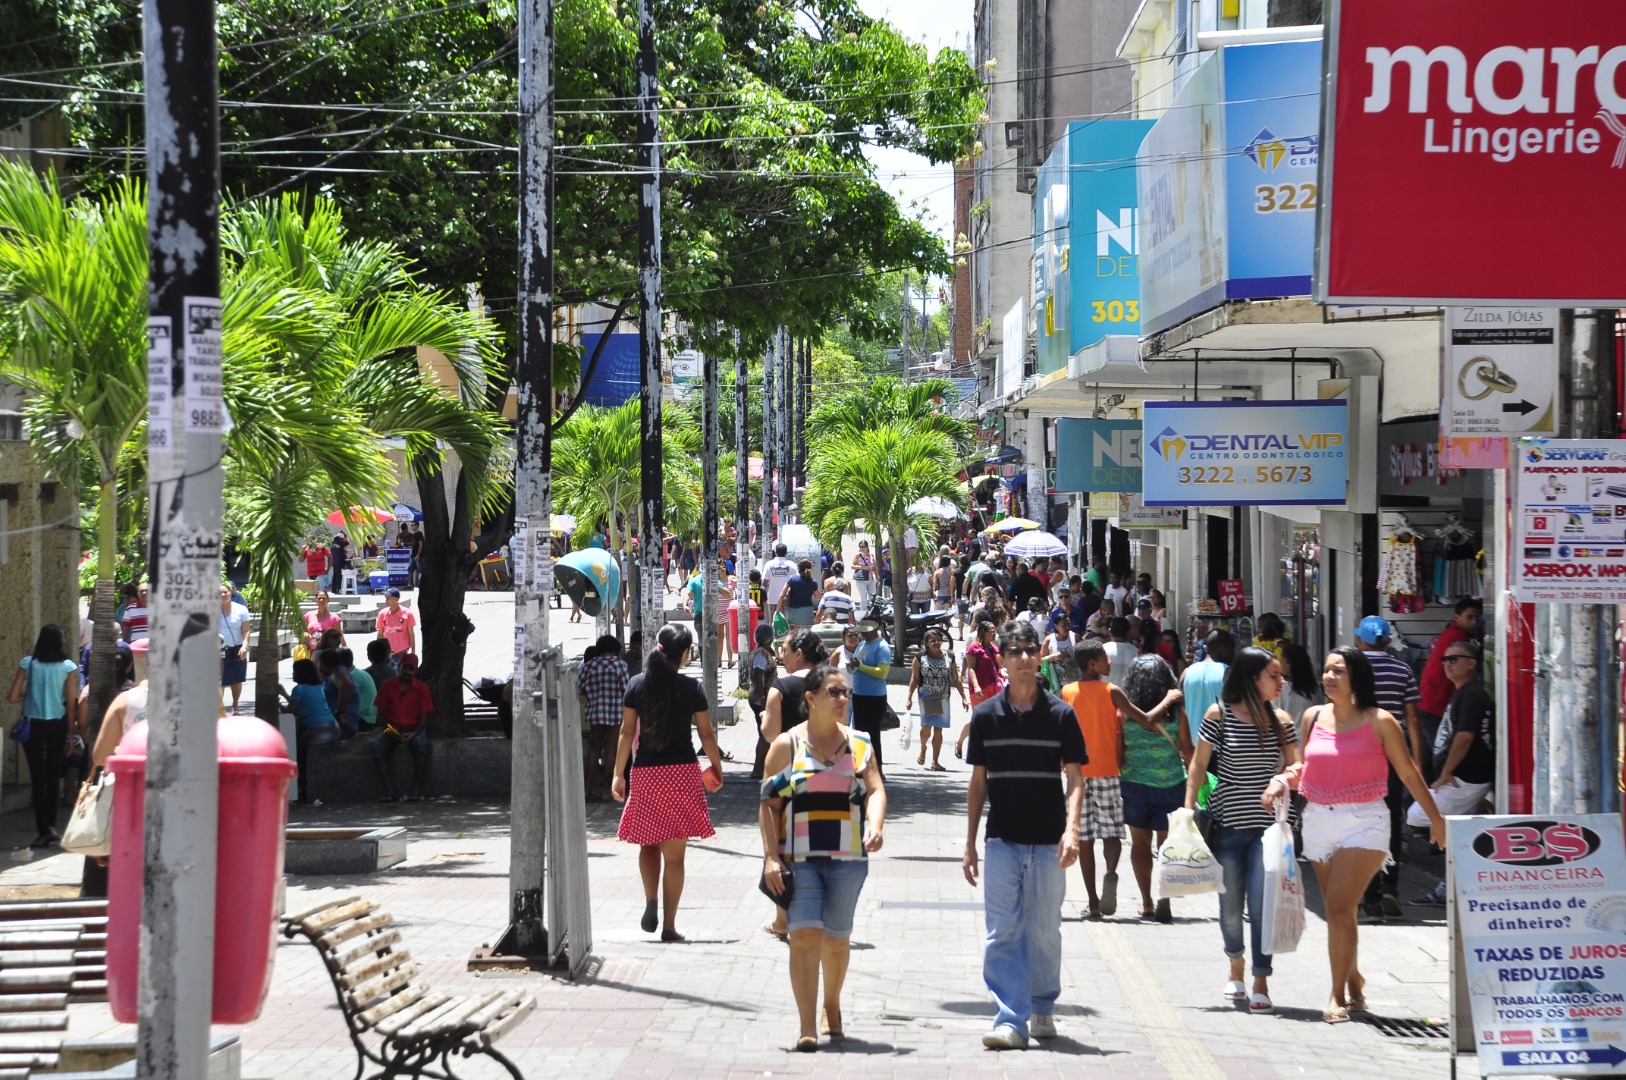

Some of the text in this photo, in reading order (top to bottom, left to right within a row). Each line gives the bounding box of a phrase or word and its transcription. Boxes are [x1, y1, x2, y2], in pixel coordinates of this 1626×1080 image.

[1282, 136, 1319, 155] D
[1425, 119, 1601, 161] Lingerie
[1096, 207, 1139, 256] N
[1096, 255, 1139, 276] DE
[1091, 300, 1139, 323] 303
[1463, 307, 1502, 322] ZILDA
[1093, 430, 1142, 467] NE
[1190, 452, 1239, 460] CENTRO
[1178, 465, 1235, 484] 3222
[1256, 465, 1312, 483] 5673
[1523, 563, 1592, 578] XEROX
[1477, 867, 1604, 882] FINANCEIRA
[1542, 881, 1605, 890] CONSIGNADOS
[1467, 897, 1587, 912] Precisando de
[1488, 916, 1572, 931] dinheiro?
[1474, 944, 1626, 962] TAXAS DE JUROS
[1498, 966, 1605, 982] REDUZIDAS
[1493, 993, 1624, 1006] TRABALHAMOS COM
[1497, 1006, 1623, 1019] TODOS OS BANCOS
[1518, 1051, 1590, 1064] SALA 04
